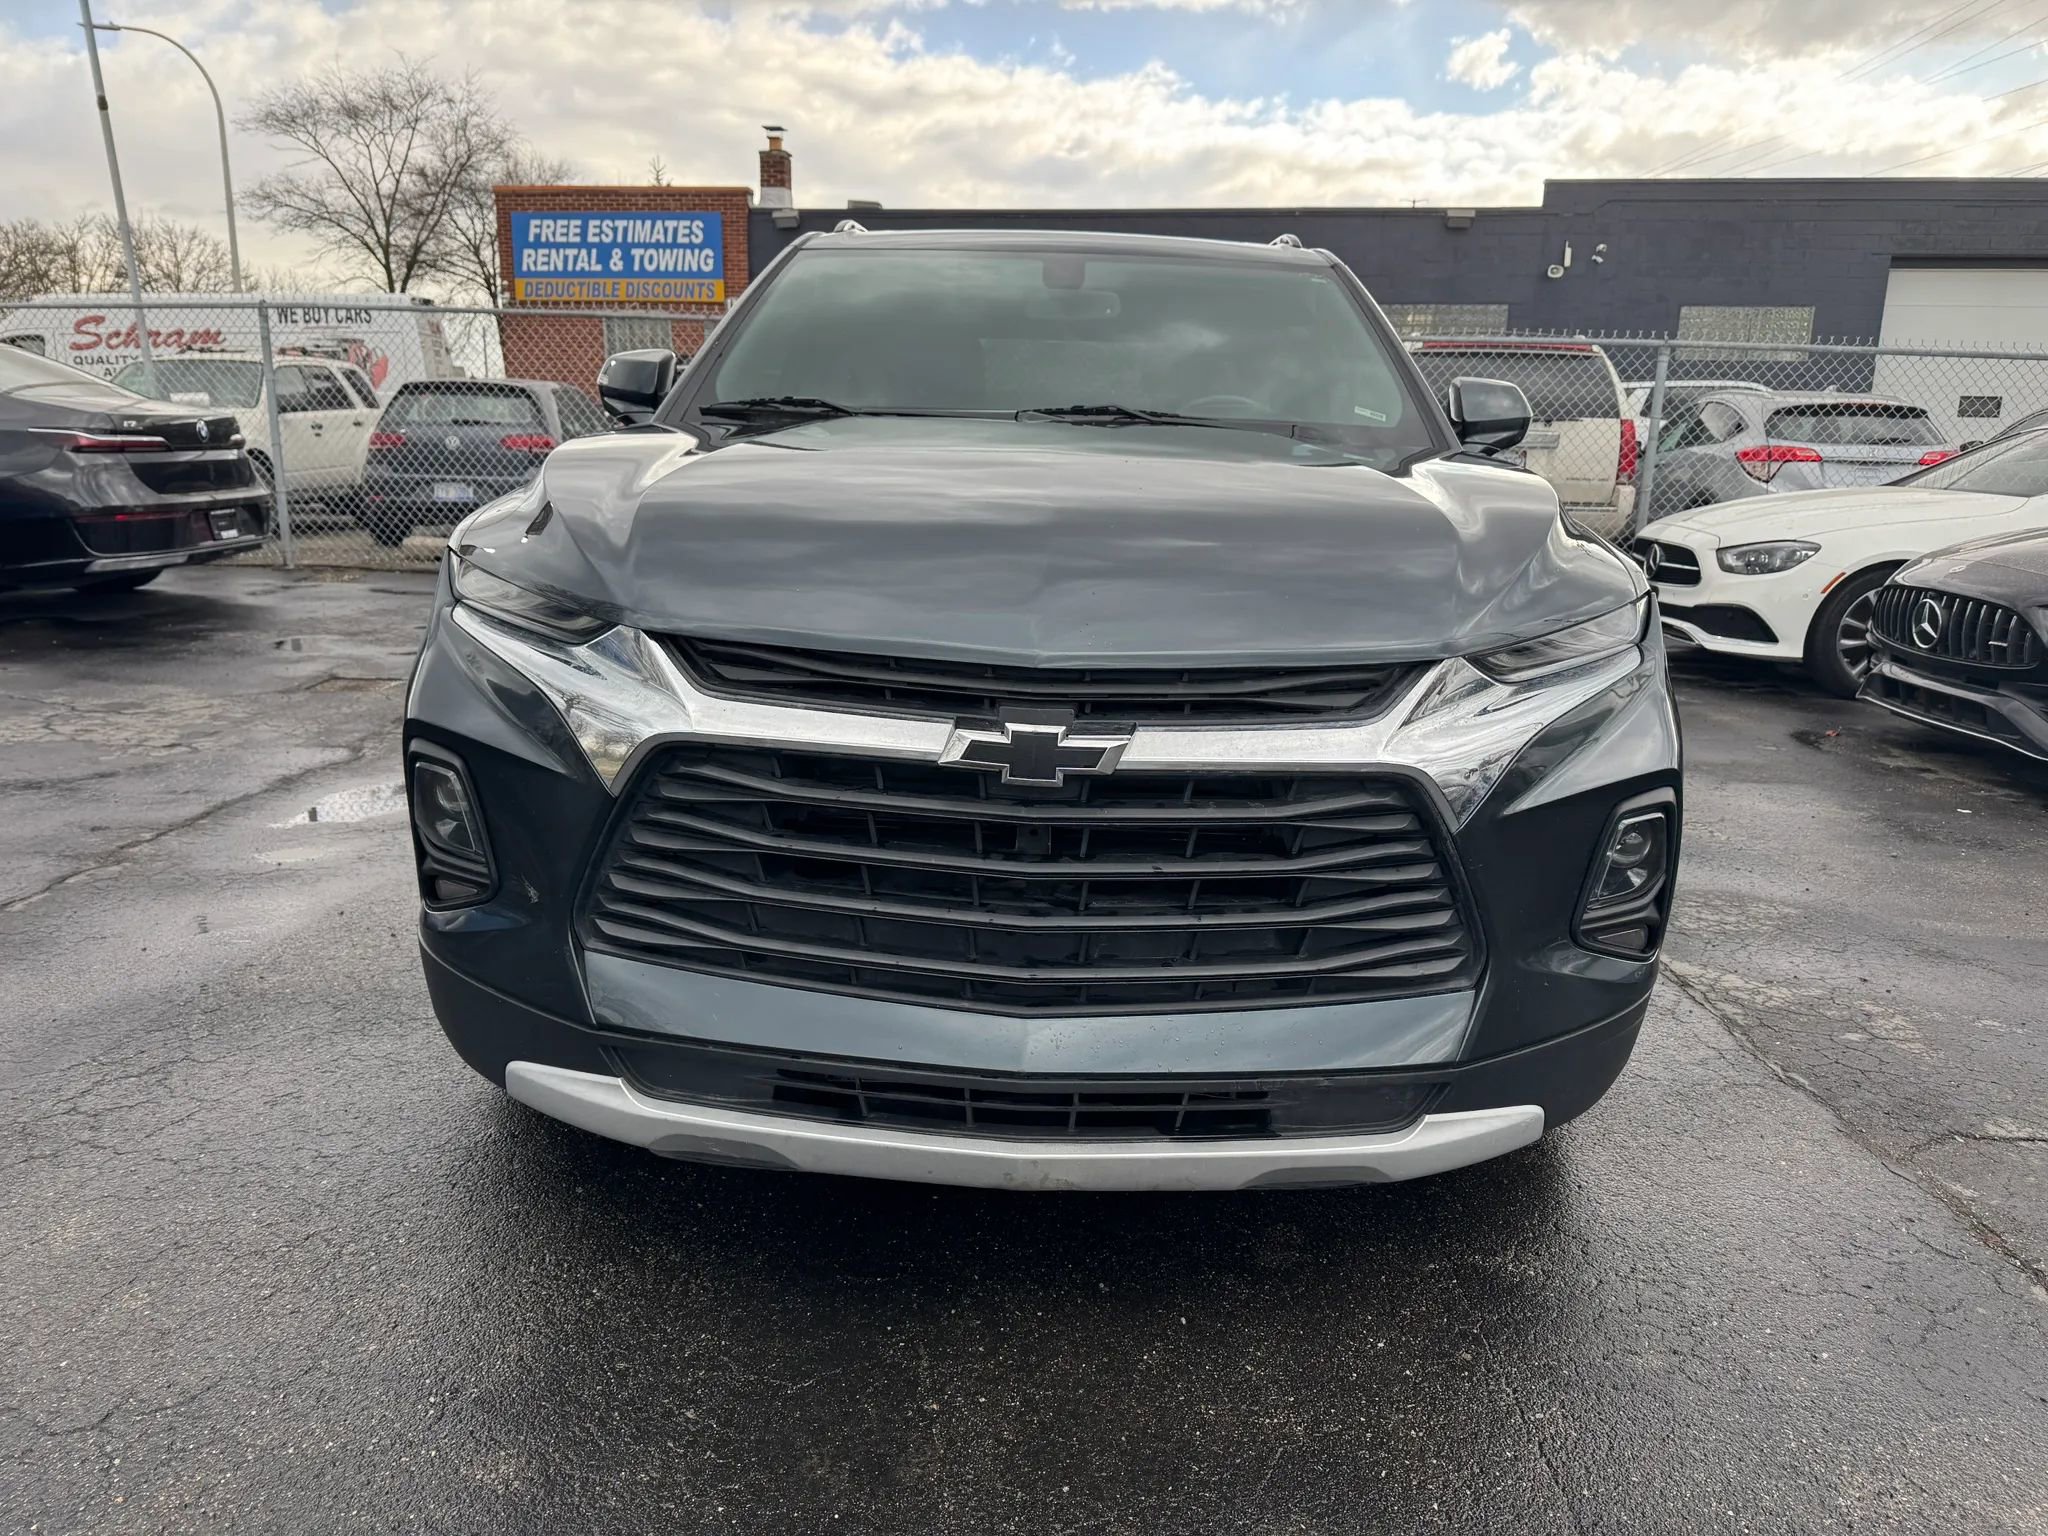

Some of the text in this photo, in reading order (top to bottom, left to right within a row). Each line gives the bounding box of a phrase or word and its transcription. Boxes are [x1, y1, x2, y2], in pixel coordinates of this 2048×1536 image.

[528, 219, 704, 244] FREE ESTIMATES
[522, 248, 715, 273] RENTAL & TOWING
[524, 281, 715, 299] DEDUCTIBLE DISCOUNTS
[277, 307, 372, 324] WE BUY CARS
[68, 315, 227, 351] Schram
